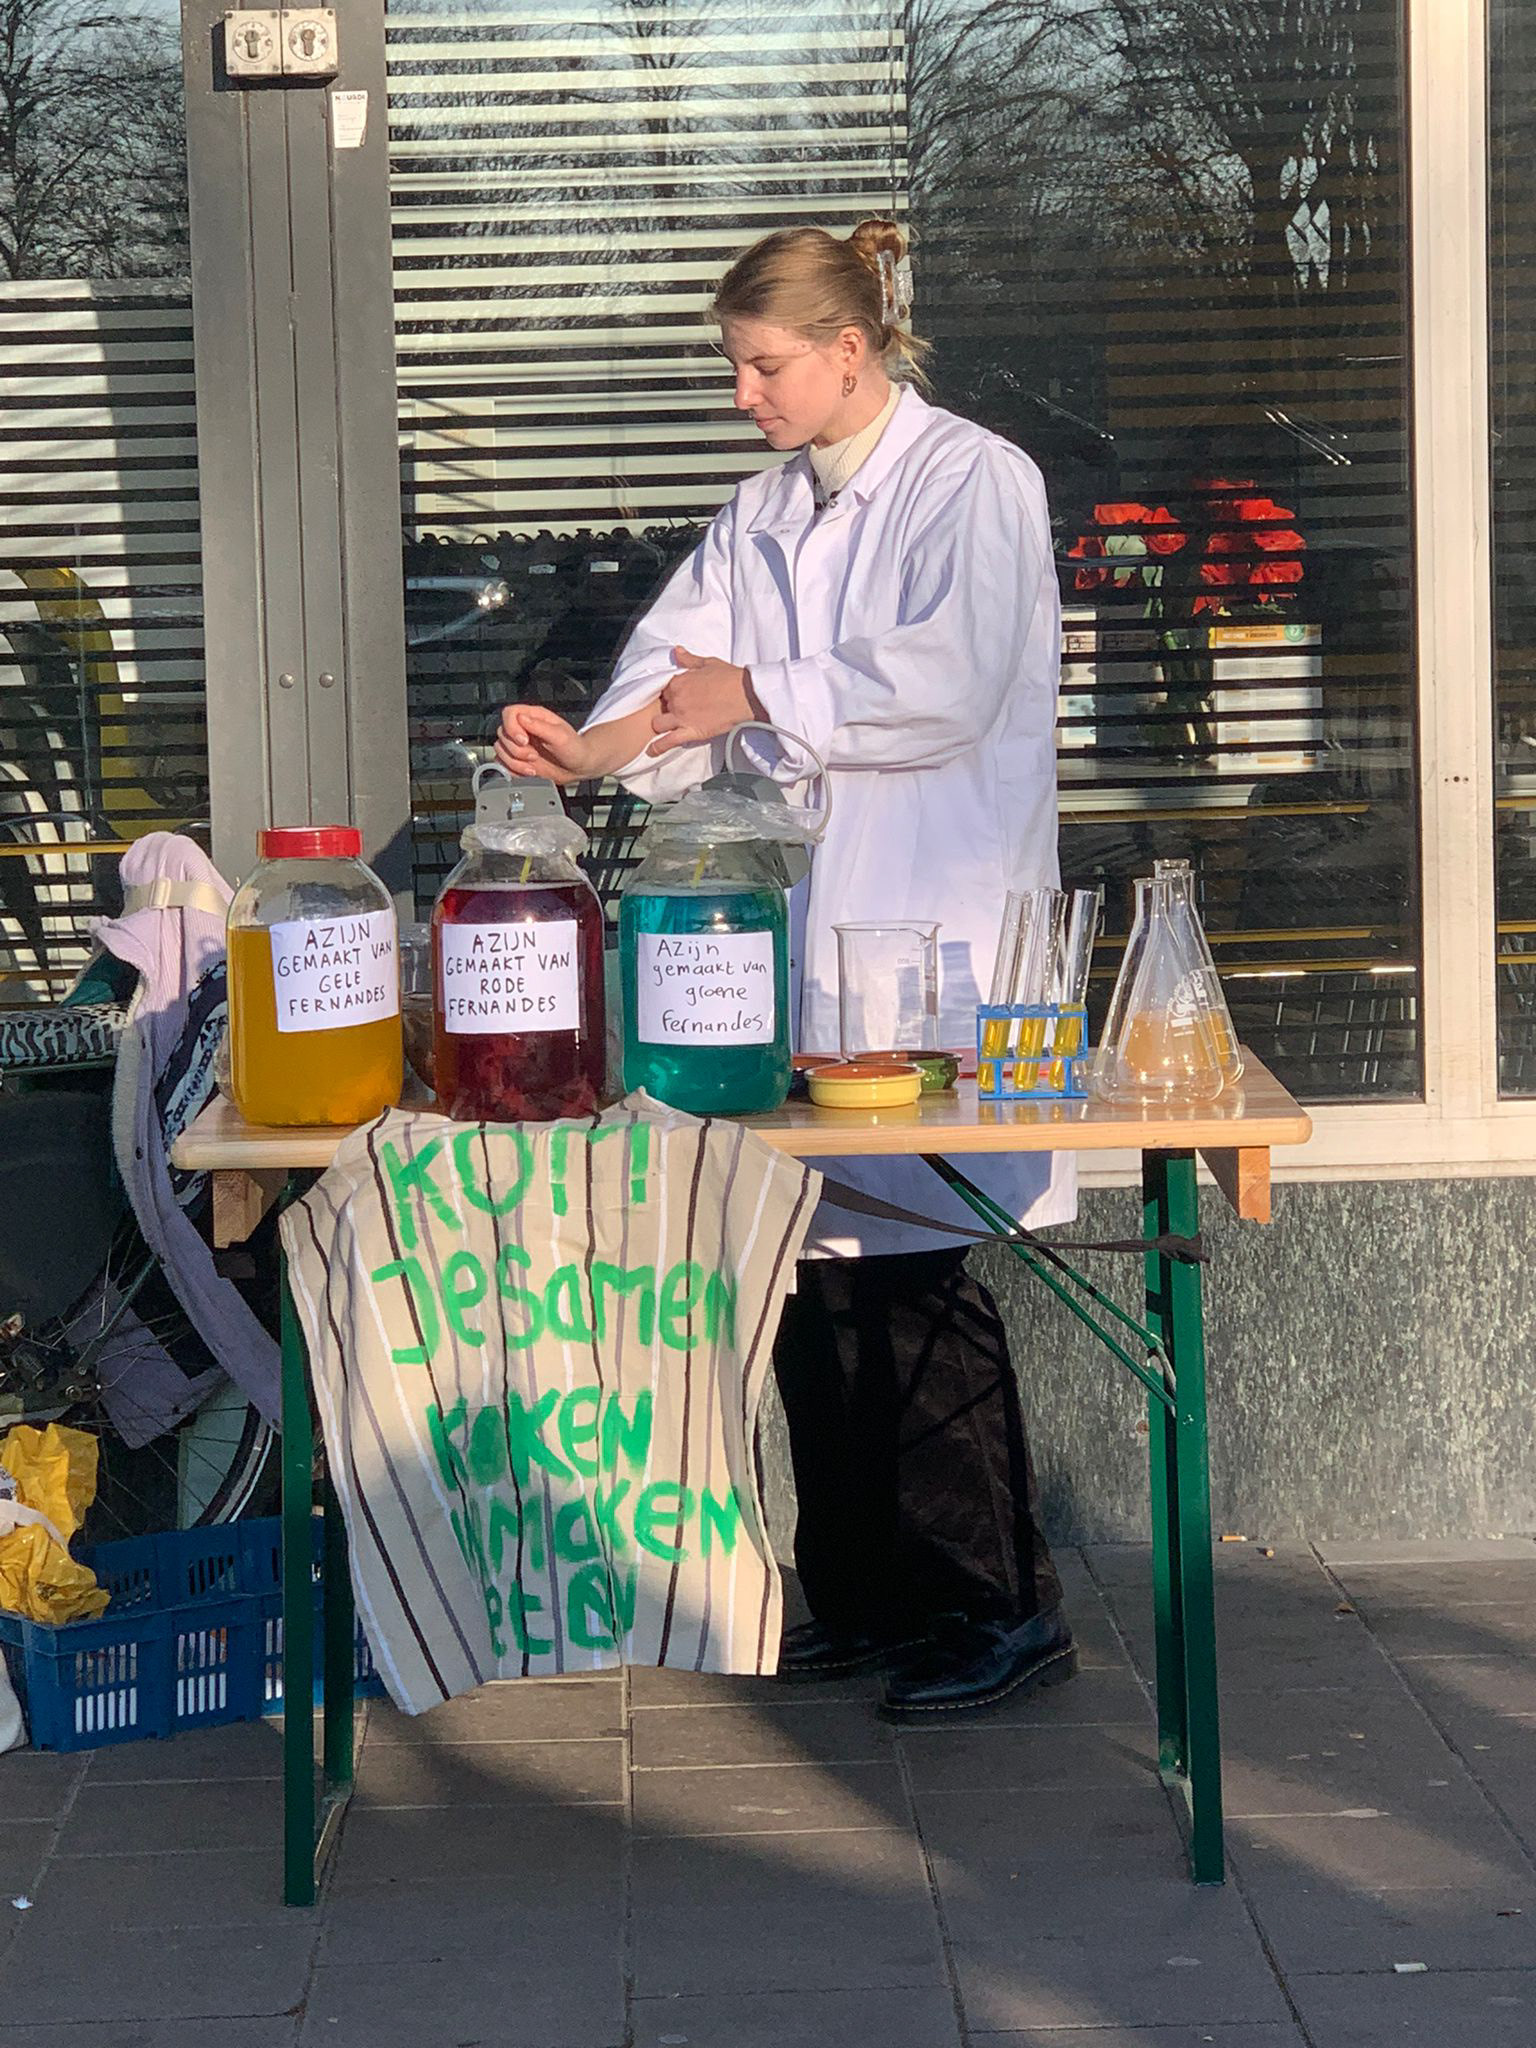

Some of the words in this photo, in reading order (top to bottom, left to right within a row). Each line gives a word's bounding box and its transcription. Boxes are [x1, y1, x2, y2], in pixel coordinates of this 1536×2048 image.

[305, 919, 371, 951] AZIJN
[472, 931, 536, 954] AZIJN
[277, 948, 361, 977] GEMAAKT
[371, 940, 392, 960] VAN
[446, 955, 526, 976] GEMAAKT
[537, 952, 570, 971] VAN
[319, 971, 361, 993] GELE
[480, 977, 525, 994] RODE
[653, 961, 735, 986] gemaakt
[289, 985, 386, 1016] FERNANDES
[448, 995, 557, 1017] FERNANDES
[685, 985, 748, 1007] groene
[381, 1121, 651, 1250] KOM
